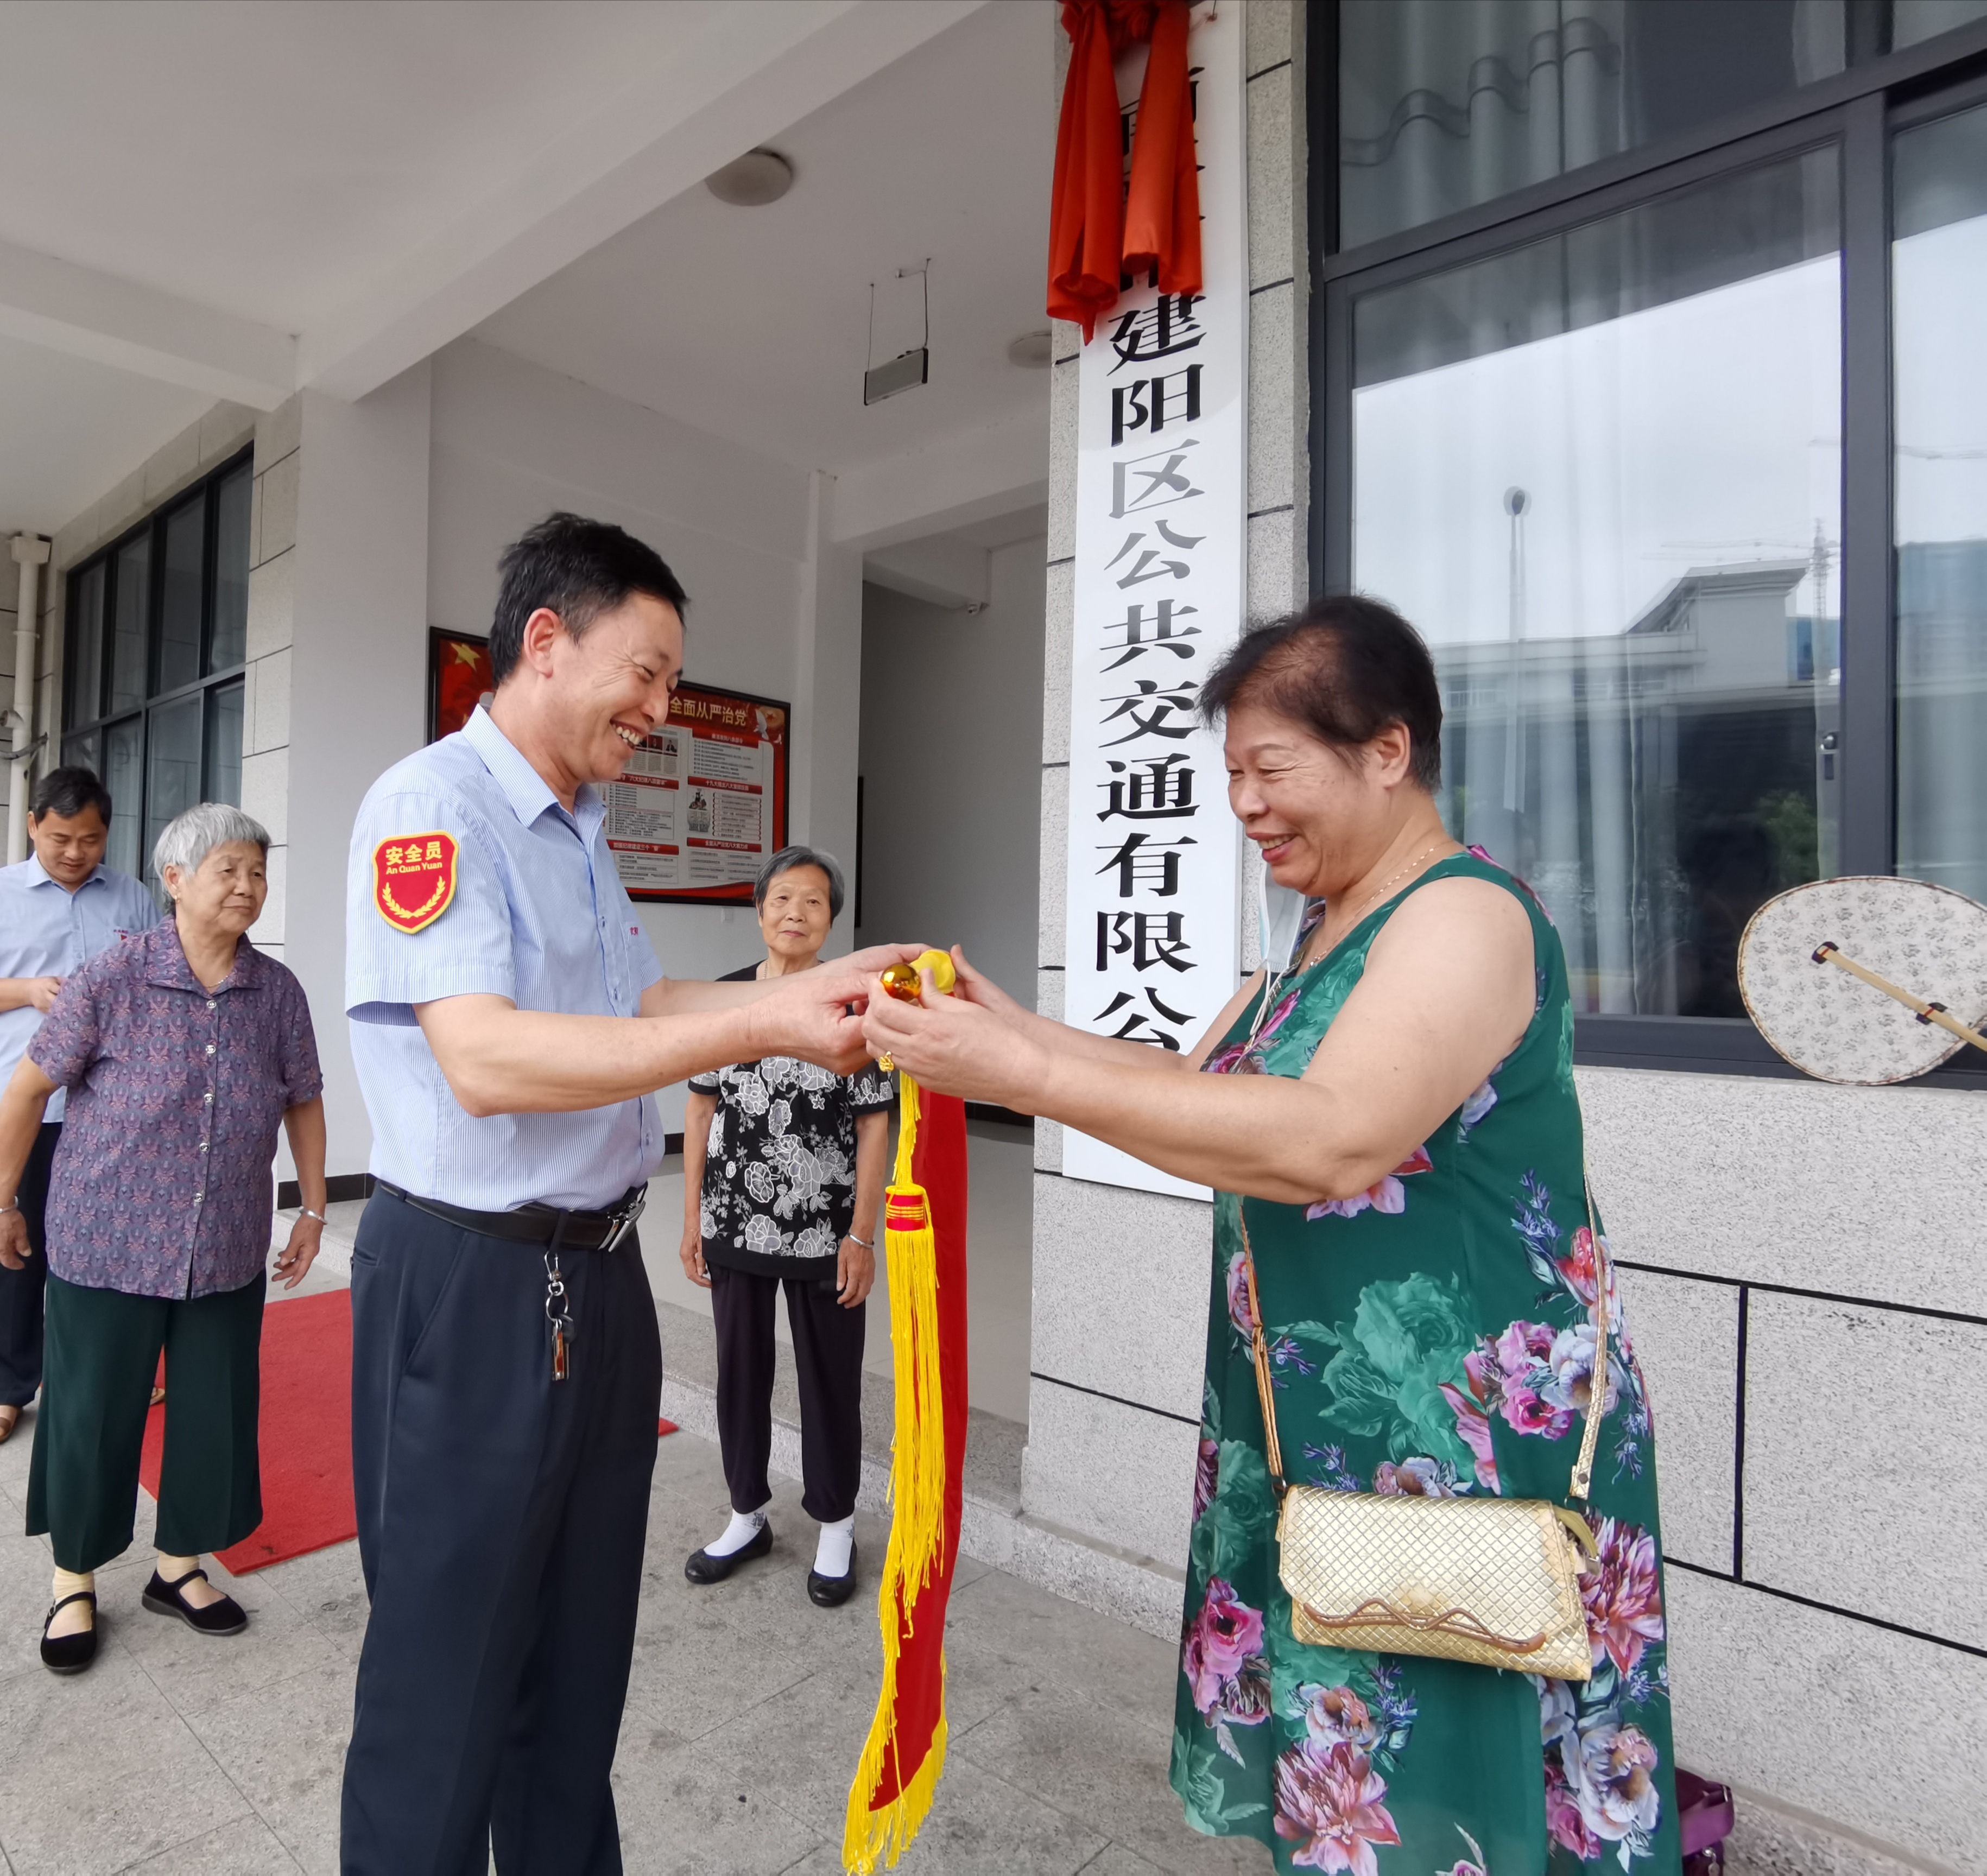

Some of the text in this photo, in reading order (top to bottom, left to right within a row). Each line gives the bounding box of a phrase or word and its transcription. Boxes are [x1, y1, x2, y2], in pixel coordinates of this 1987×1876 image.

[1093, 66, 1207, 1053] 建阳区公共交通有限公
[670, 696, 746, 726] 全面从严治党
[385, 841, 442, 865] 安全员
[399, 865, 420, 873] Quan
[421, 862, 442, 870] Yuan
